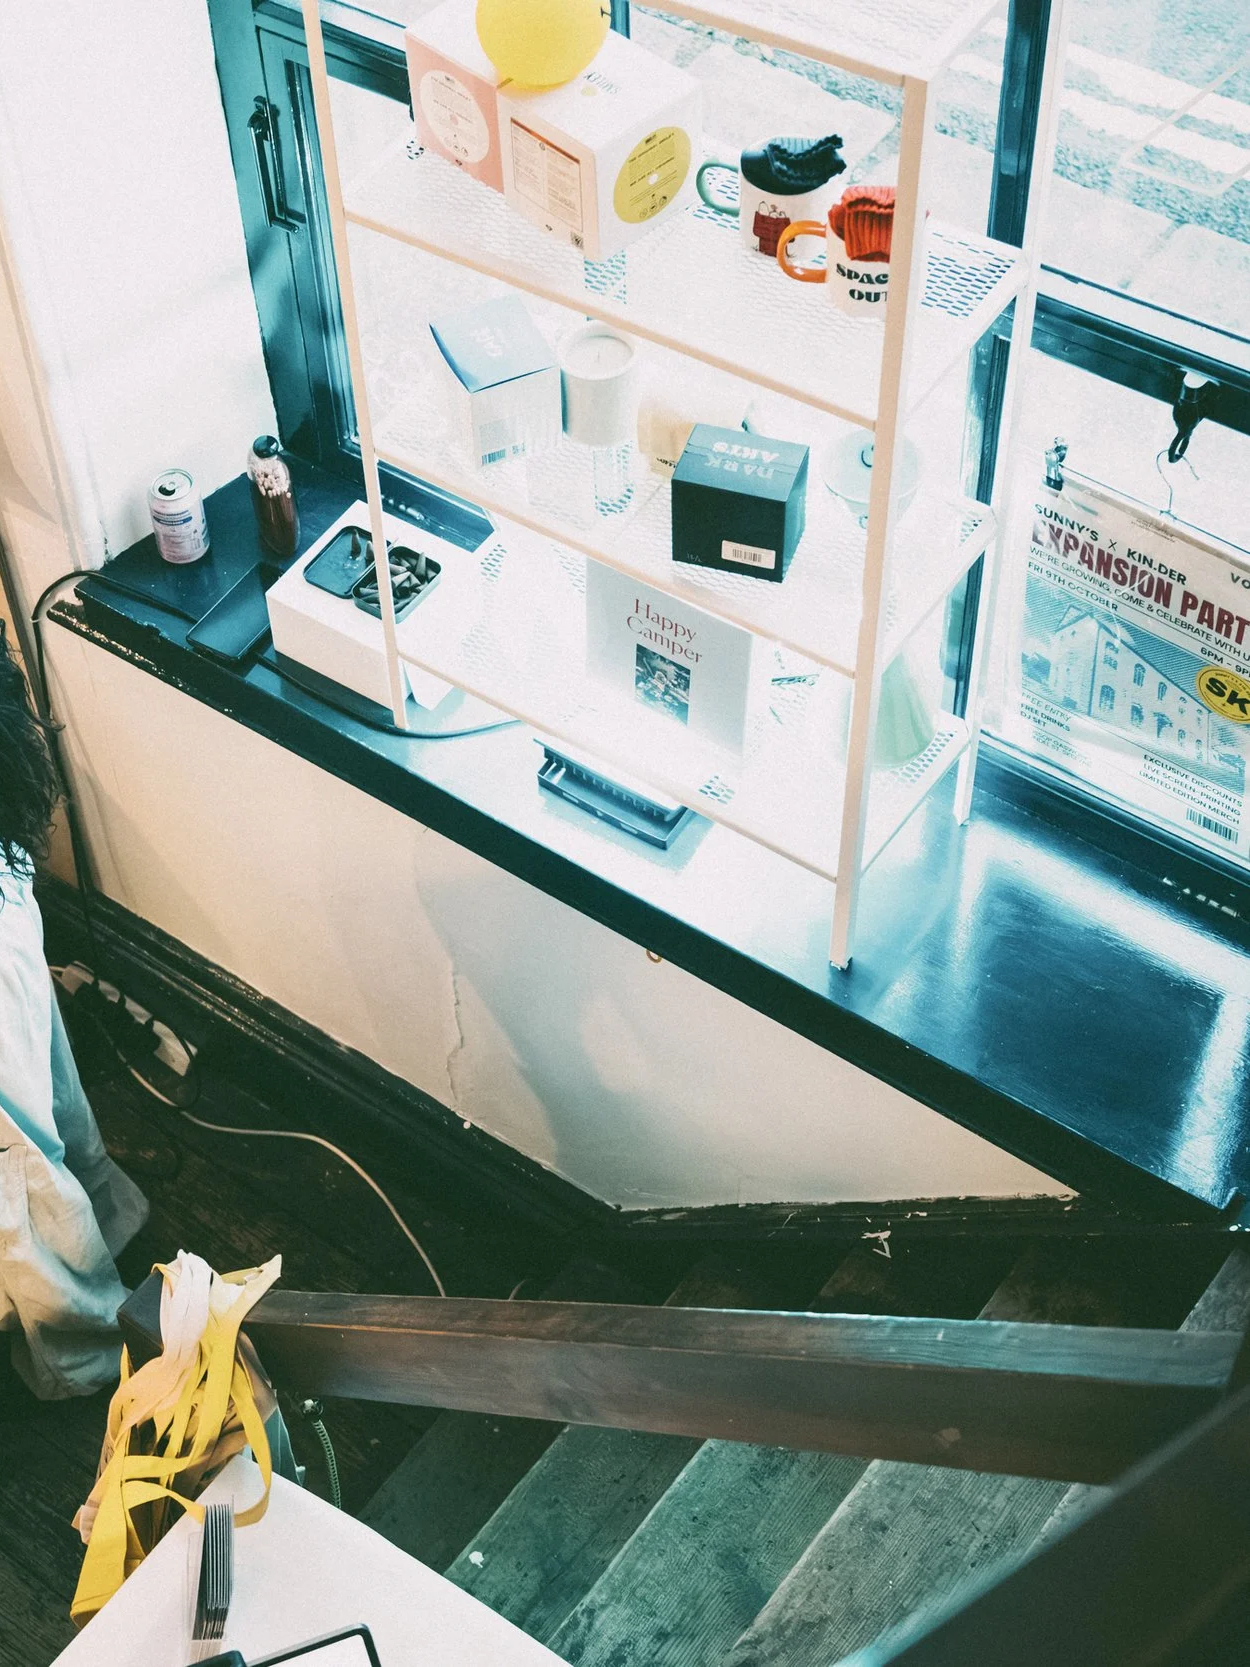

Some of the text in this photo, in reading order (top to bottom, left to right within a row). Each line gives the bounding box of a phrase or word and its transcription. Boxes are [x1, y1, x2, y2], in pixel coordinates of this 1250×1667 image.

[836, 262, 889, 285] SPAC
[704, 453, 775, 479] DARK
[712, 441, 780, 463] ARTS
[1034, 503, 1099, 542] SUNNY'S
[1126, 548, 1187, 586] KIN.DER
[1031, 519, 1250, 645] EXPANSION PART
[1230, 571, 1250, 590] VO
[635, 598, 697, 643] Happy
[1028, 561, 1043, 574] FRI
[1045, 569, 1066, 586] 9TH
[1068, 582, 1118, 612] OCTOBER
[1200, 646, 1224, 664] 6PM
[1235, 664, 1250, 678] 9P
[1030, 546, 1060, 567] WE'RE
[1114, 588, 1145, 608] COME
[1146, 603, 1154, 612] &
[1156, 608, 1213, 642] CELEBRATE
[1215, 636, 1241, 657] WITH
[1243, 652, 1250, 662] U
[627, 615, 703, 663] Camper
[1032, 717, 1047, 727] SET
[1041, 712, 1071, 732] DRINKS
[1044, 704, 1071, 722] ENTRY
[1139, 770, 1240, 825] LIMITED EDITION MERCH
[1143, 754, 1243, 807] EXCLUSIVE DISCOUNTS
[1143, 763, 1241, 816] LIVE SCREEN-PRINTING
